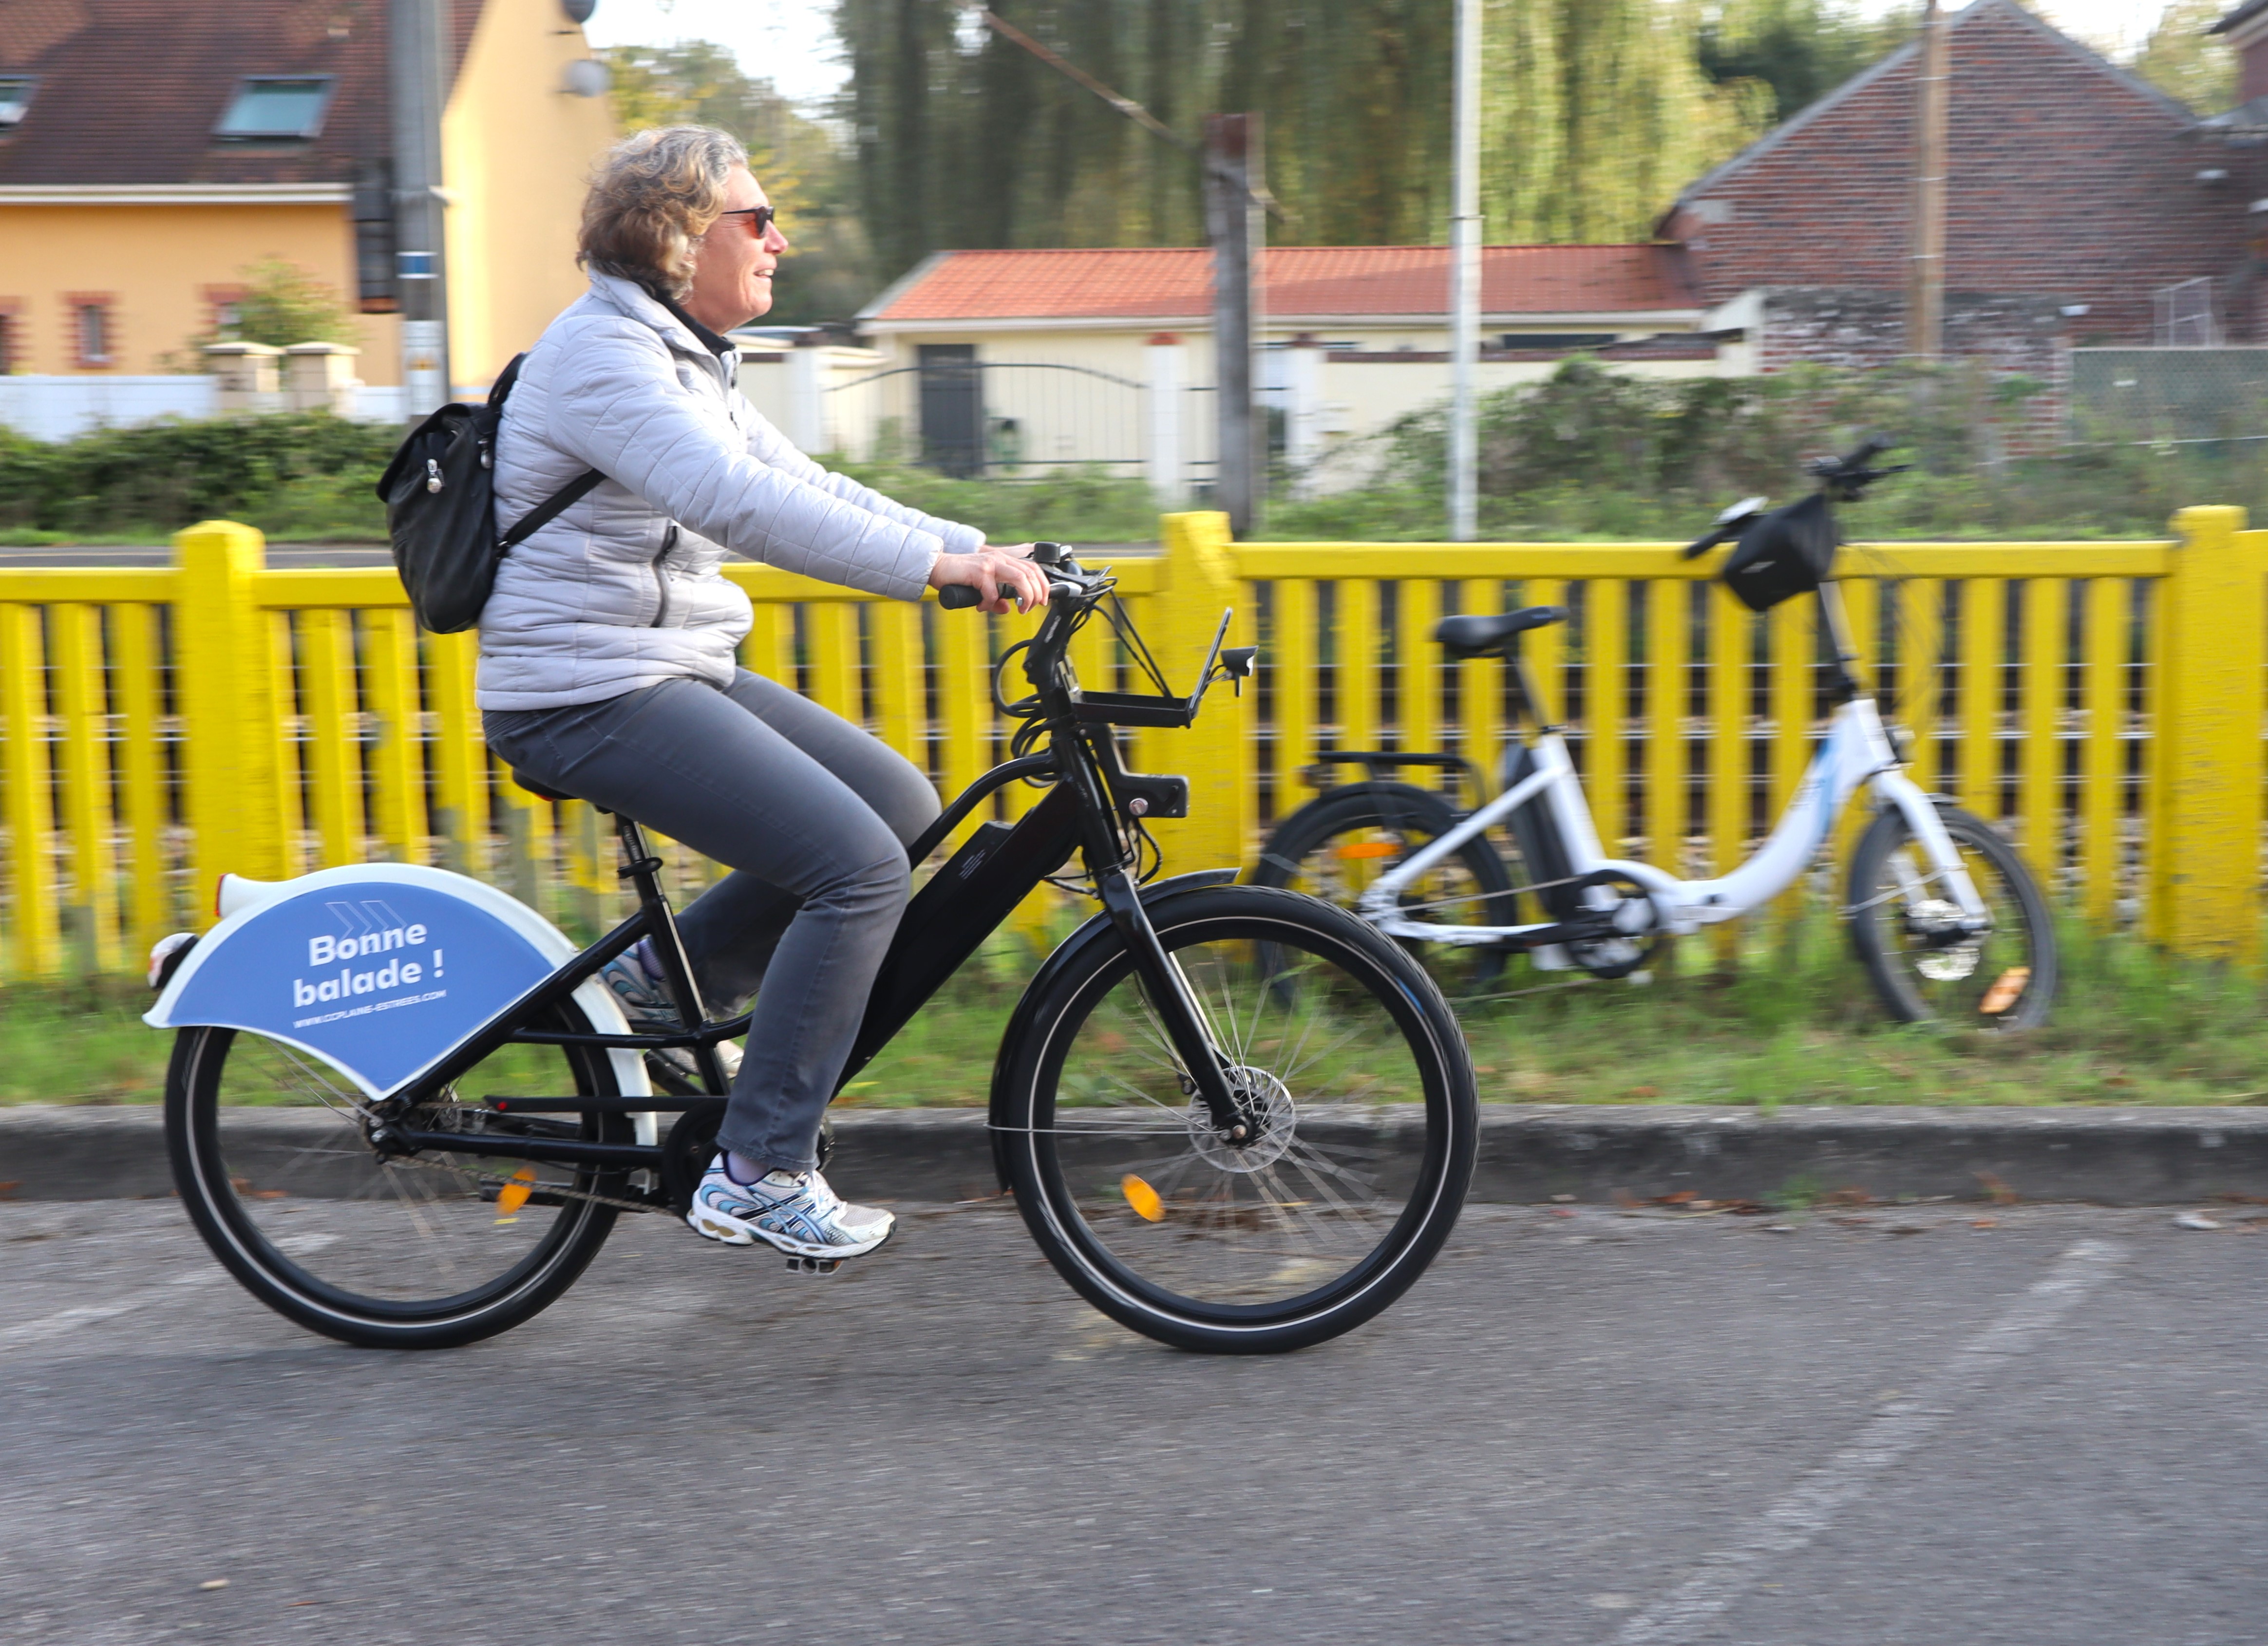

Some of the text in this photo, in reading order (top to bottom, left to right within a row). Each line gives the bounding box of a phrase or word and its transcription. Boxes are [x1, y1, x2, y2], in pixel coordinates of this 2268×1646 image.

[308, 923, 428, 967] Bonne
[293, 949, 444, 1008] balade !
